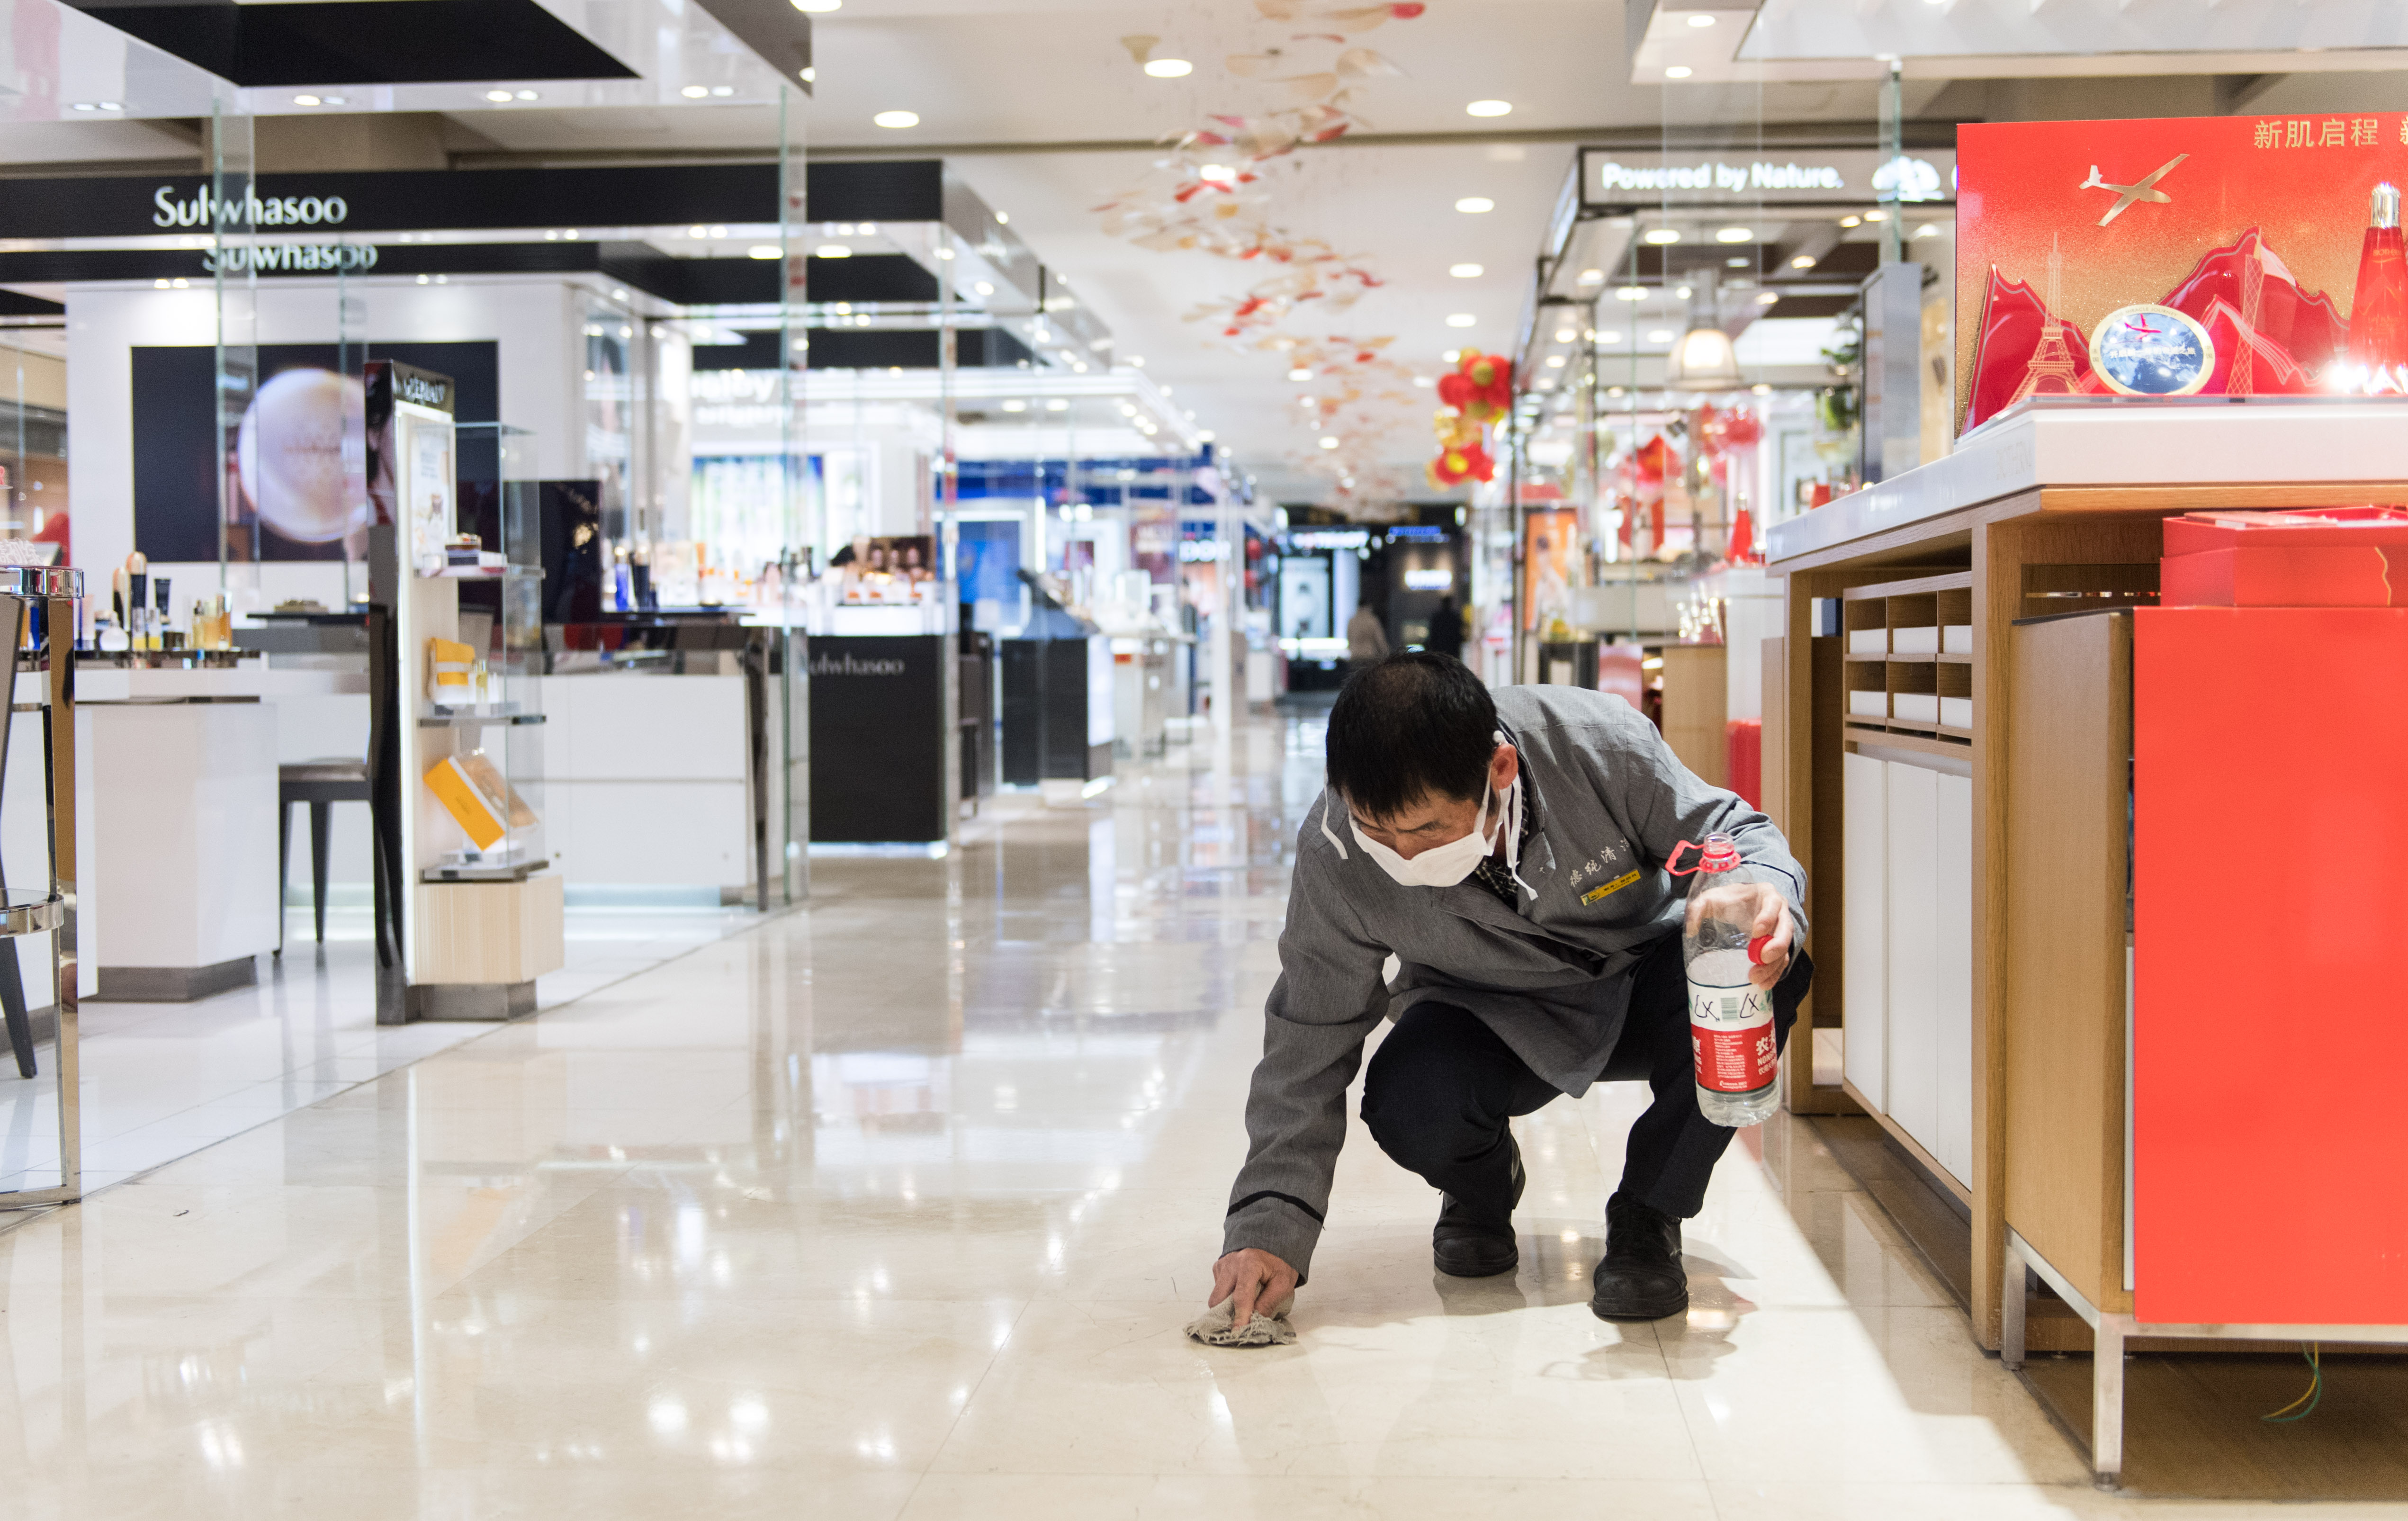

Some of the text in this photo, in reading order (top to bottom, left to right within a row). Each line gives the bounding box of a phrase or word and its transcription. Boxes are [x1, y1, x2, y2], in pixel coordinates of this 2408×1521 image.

[2254, 118, 2379, 149] 新肌启程
[1602, 162, 1844, 192] Powered by Nature.
[153, 183, 348, 227] Sulwhasoo
[807, 651, 905, 675] ulwhasoo
